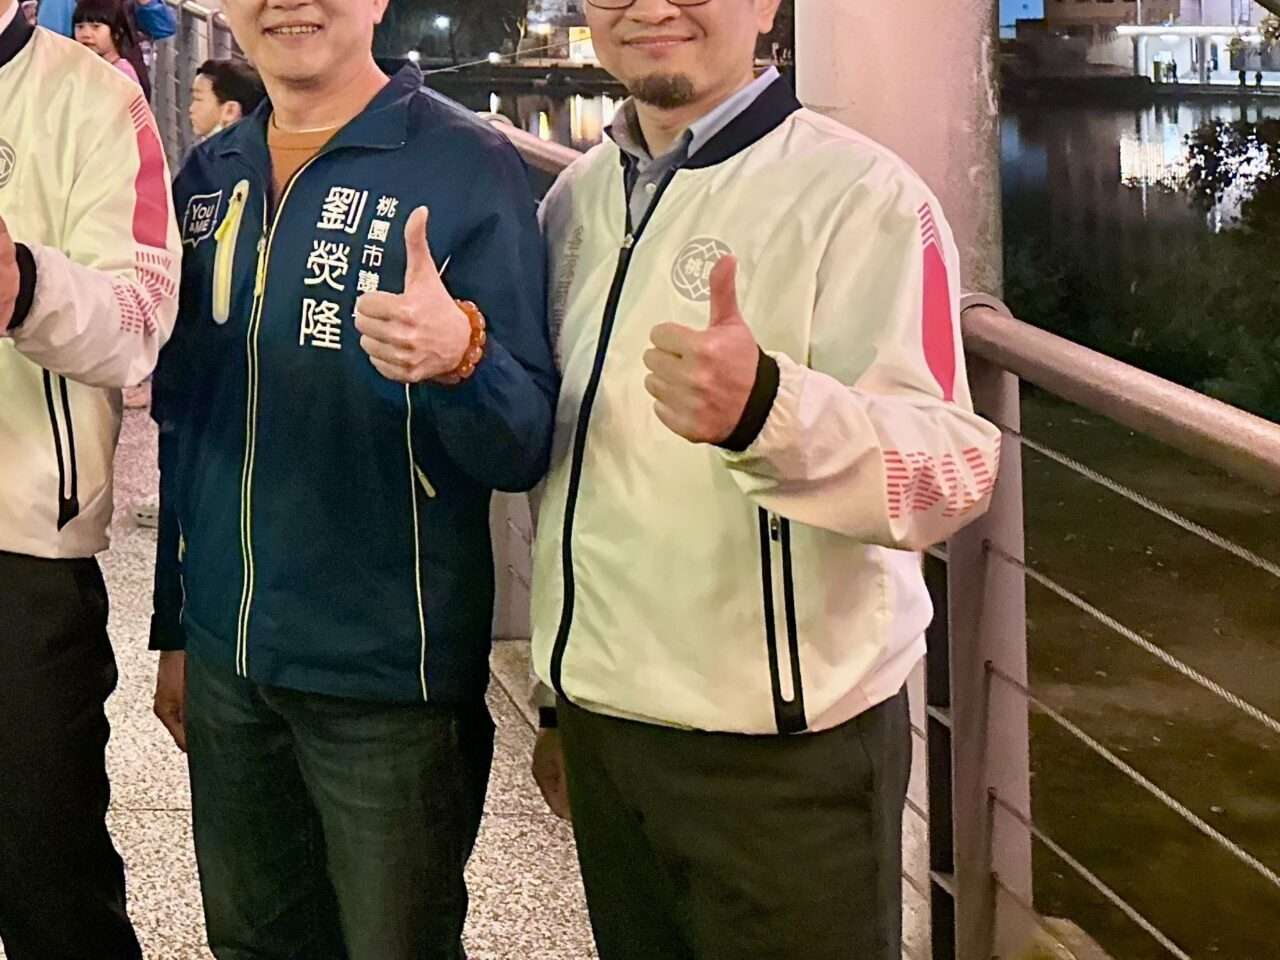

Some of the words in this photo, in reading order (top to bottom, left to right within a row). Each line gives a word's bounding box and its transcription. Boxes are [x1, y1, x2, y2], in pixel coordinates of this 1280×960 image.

[298, 185, 369, 351] 劉熒隆
[351, 194, 400, 319] 桃園市議
